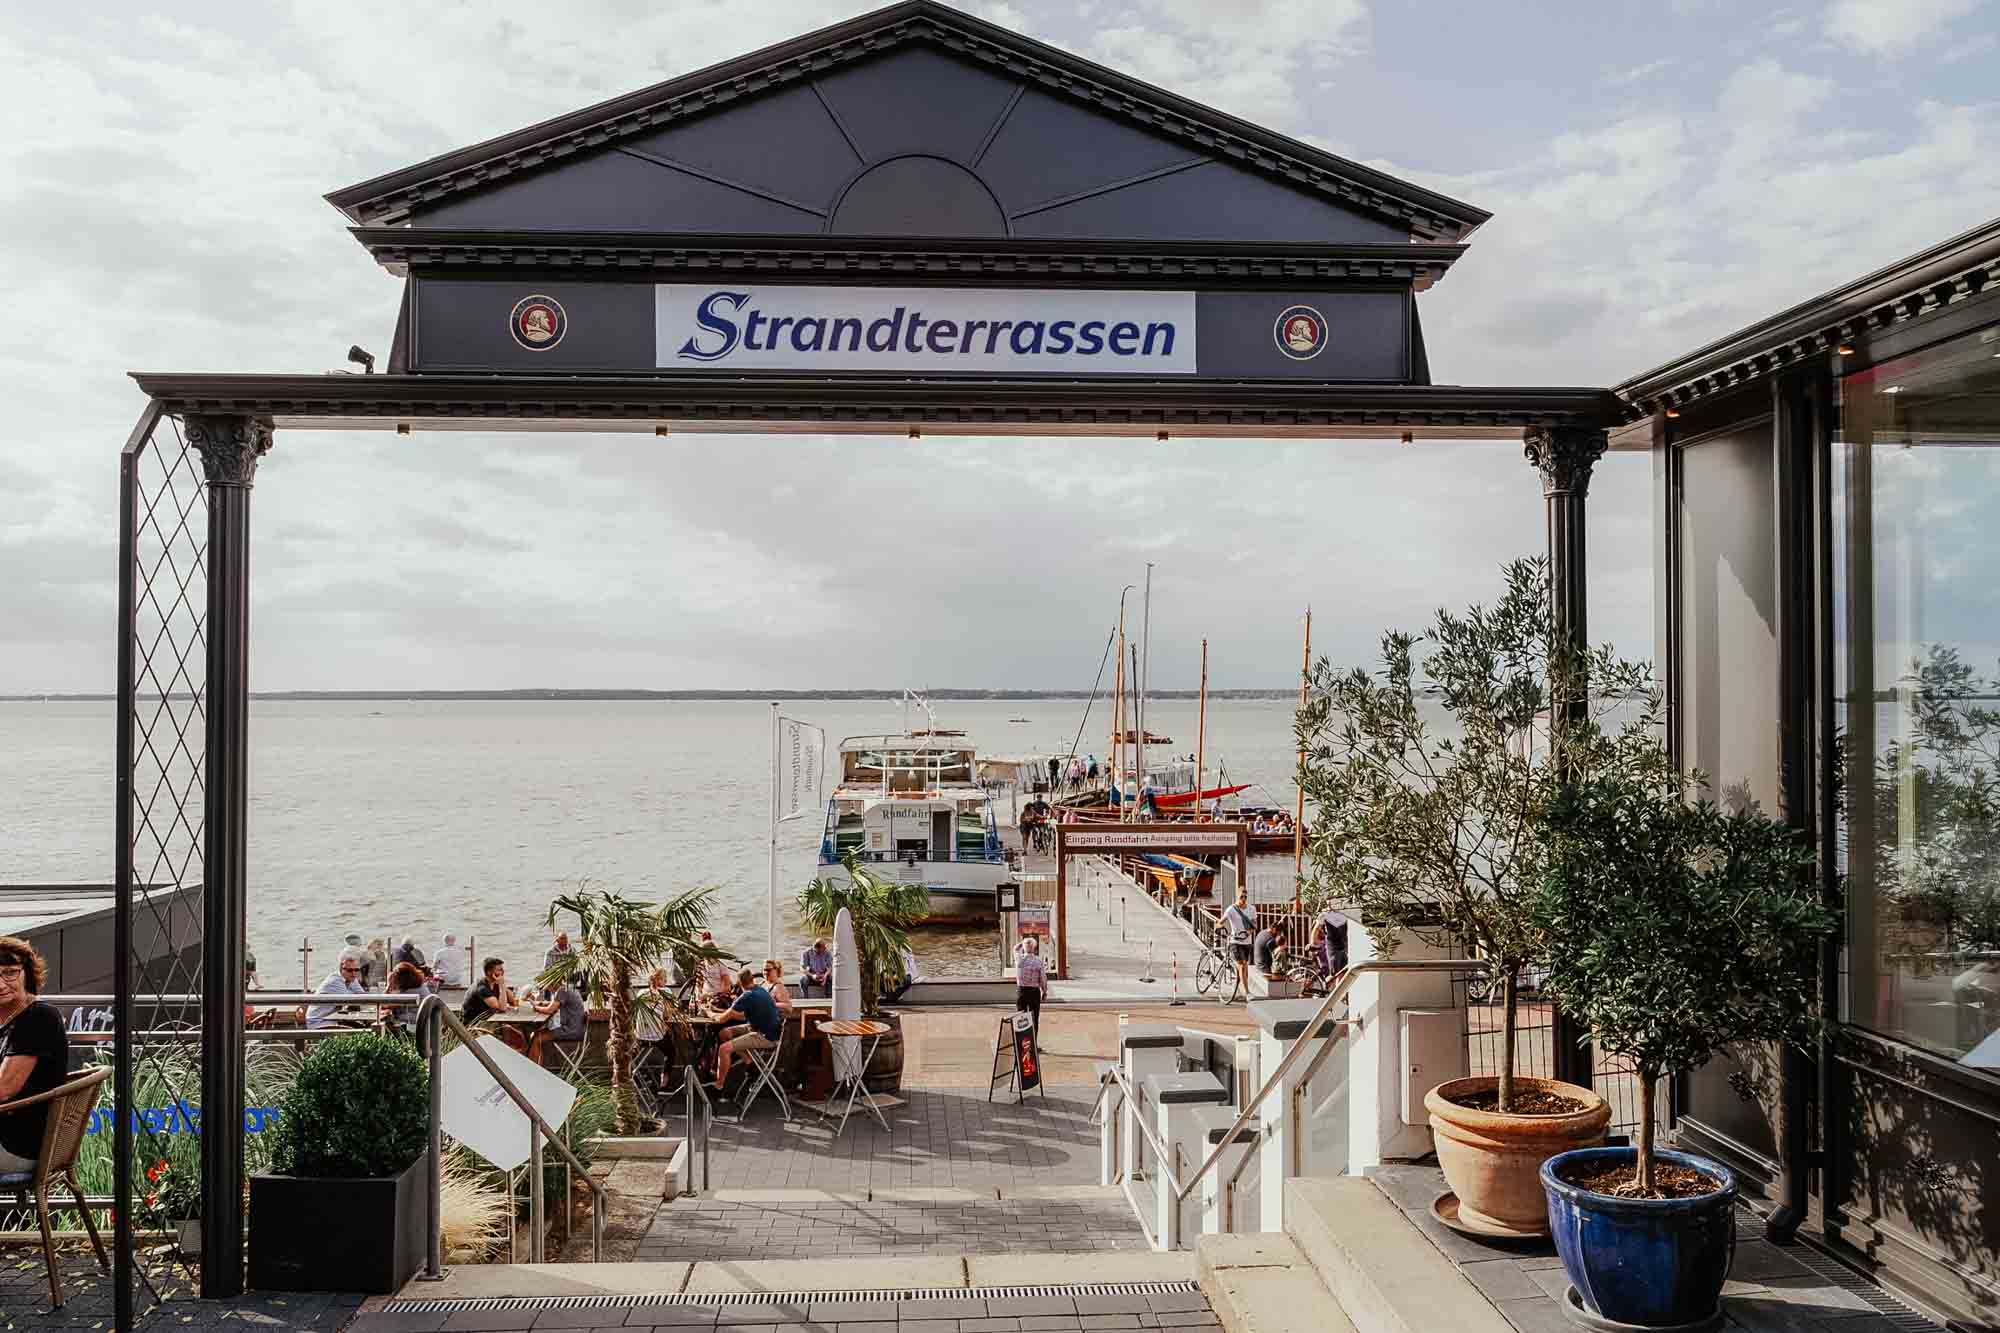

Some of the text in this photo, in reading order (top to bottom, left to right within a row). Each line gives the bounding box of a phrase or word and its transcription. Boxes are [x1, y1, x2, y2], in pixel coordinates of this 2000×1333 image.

[677, 291, 1176, 362] Strandterrassen
[1066, 835, 1102, 845] Eingang
[1104, 835, 1149, 844] Rundfahrt
